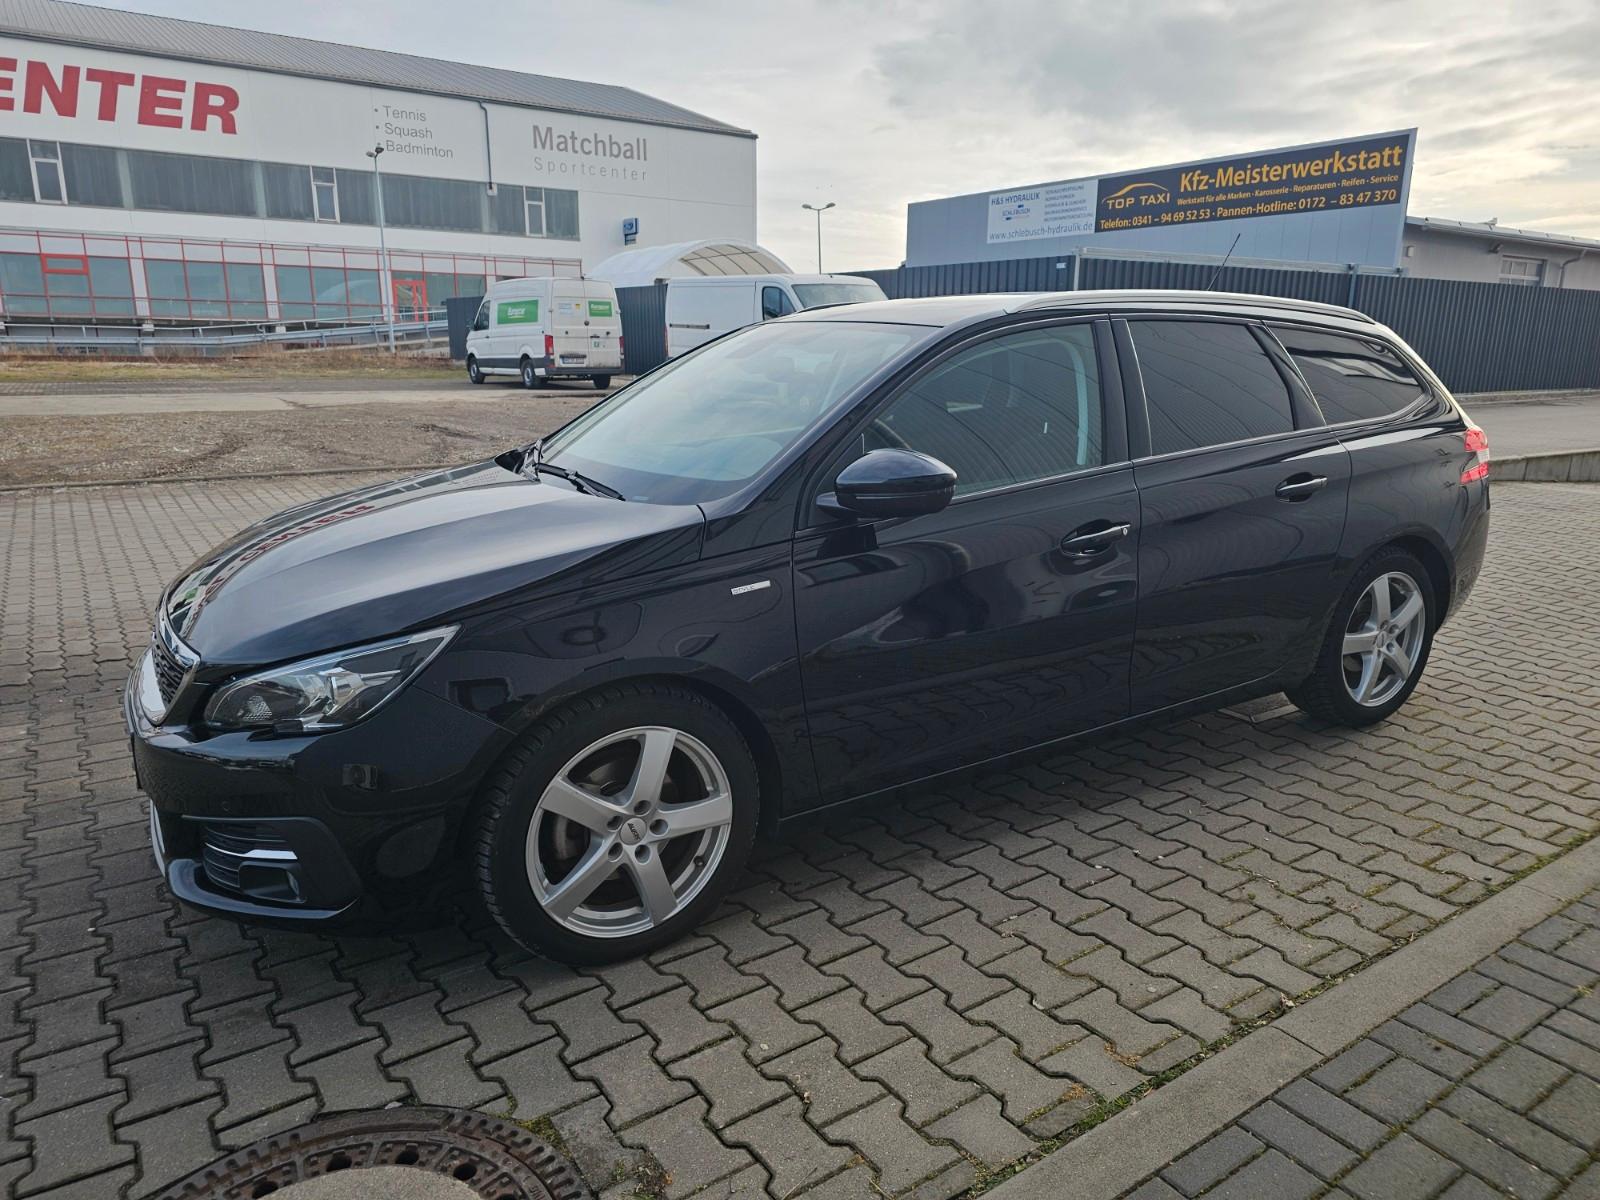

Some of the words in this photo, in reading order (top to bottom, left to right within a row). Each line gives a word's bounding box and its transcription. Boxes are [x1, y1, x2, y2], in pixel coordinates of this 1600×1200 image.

[382, 105, 427, 122] Tennis
[384, 122, 433, 140] Squash
[532, 125, 647, 161] Matchball
[386, 140, 454, 159] Badminton
[533, 157, 648, 181] Sportcenter
[1180, 145, 1402, 192] Kfz-Meisterwerkstatt
[1107, 197, 1135, 210] TOP
[1140, 193, 1170, 206] TAXI
[1177, 195, 1205, 206] Werkstatt
[1205, 193, 1215, 203] für
[1215, 193, 1226, 202] alle
[1227, 191, 1251, 201] Marken
[1254, 186, 1289, 197] Karosserie
[1293, 182, 1336, 193] Reparaturen
[1341, 177, 1365, 188] Reifen
[1370, 174, 1398, 184] Service
[1100, 218, 1131, 230] Telefon:
[1132, 215, 1152, 226] 0341
[1161, 213, 1172, 223] 94
[1173, 211, 1185, 221] 69
[1186, 210, 1197, 220] 52
[1199, 209, 1210, 219] 53
[1217, 201, 1297, 217] Pannen-Hotline:
[1298, 196, 1326, 209] 0172
[1339, 193, 1354, 206] 83
[1356, 191, 1372, 203] 47
[1373, 189, 1397, 202] 370
